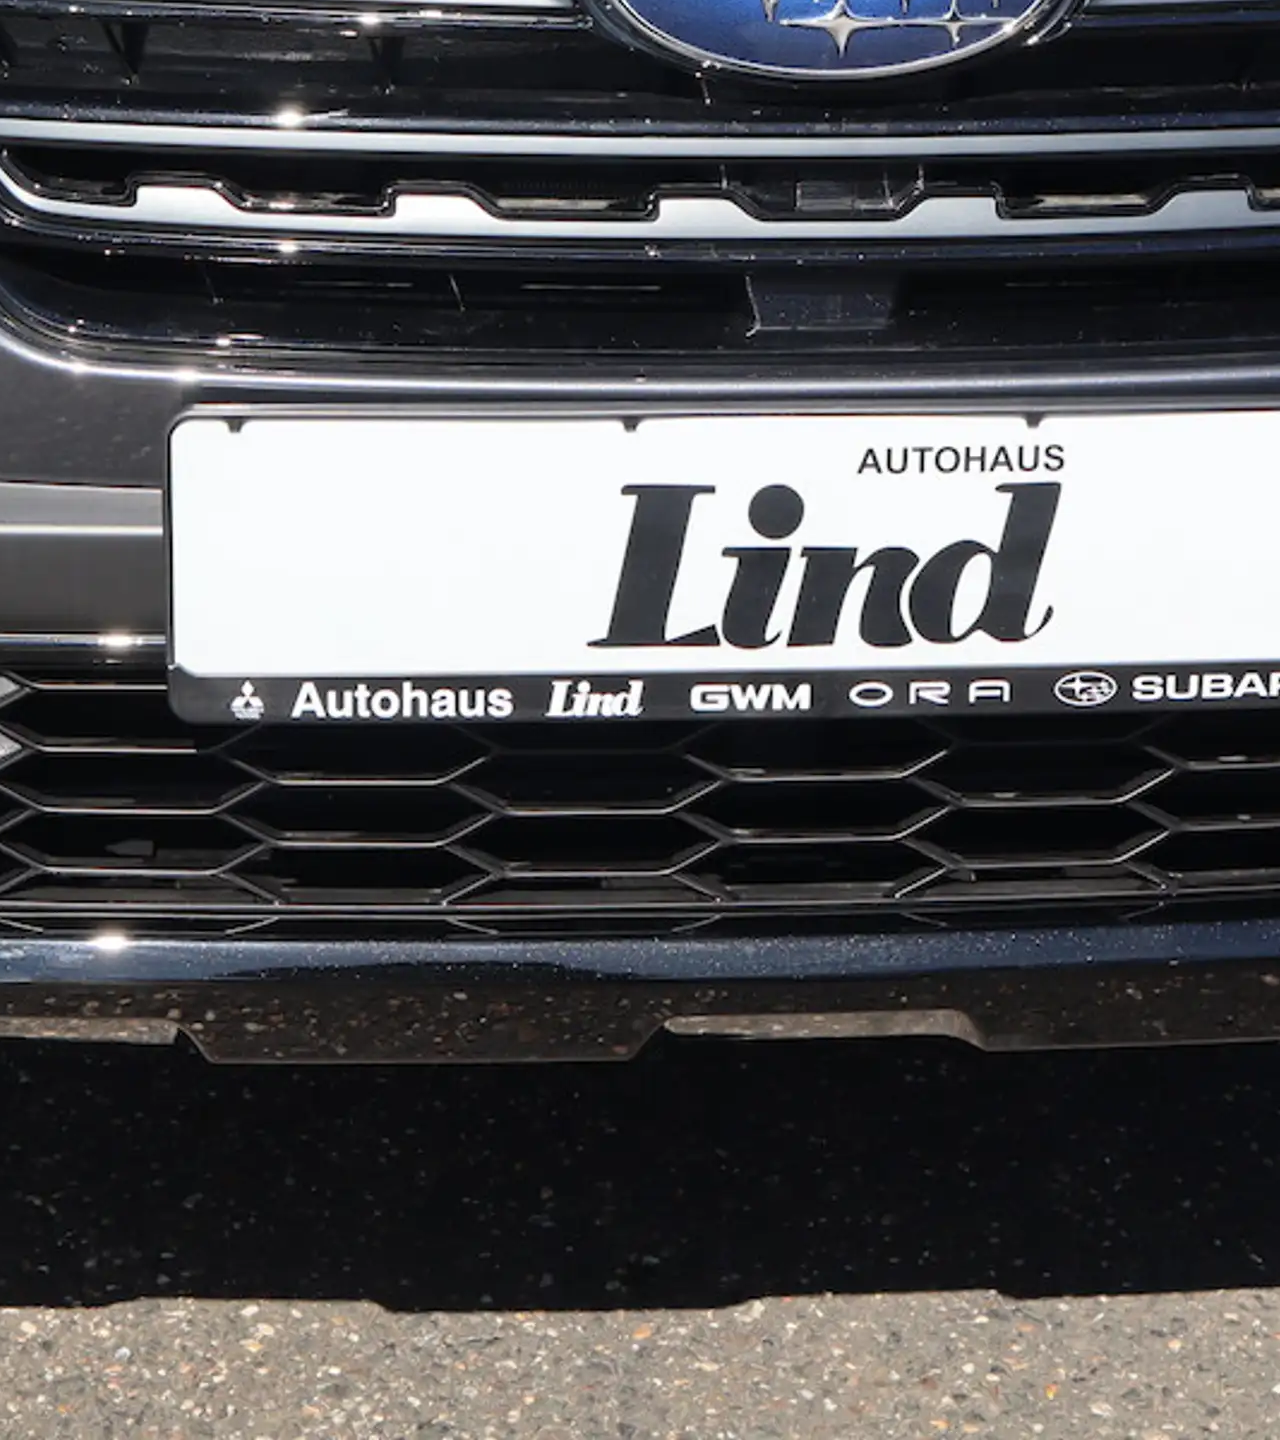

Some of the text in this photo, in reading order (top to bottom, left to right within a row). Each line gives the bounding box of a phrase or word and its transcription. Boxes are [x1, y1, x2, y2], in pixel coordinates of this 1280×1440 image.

[857, 445, 1066, 474] AUTOHAUS
[586, 482, 1062, 649] Lind
[291, 681, 514, 718] Autohaus
[545, 680, 644, 718] Lind
[690, 683, 811, 712] GWM
[849, 680, 1011, 707] ORA
